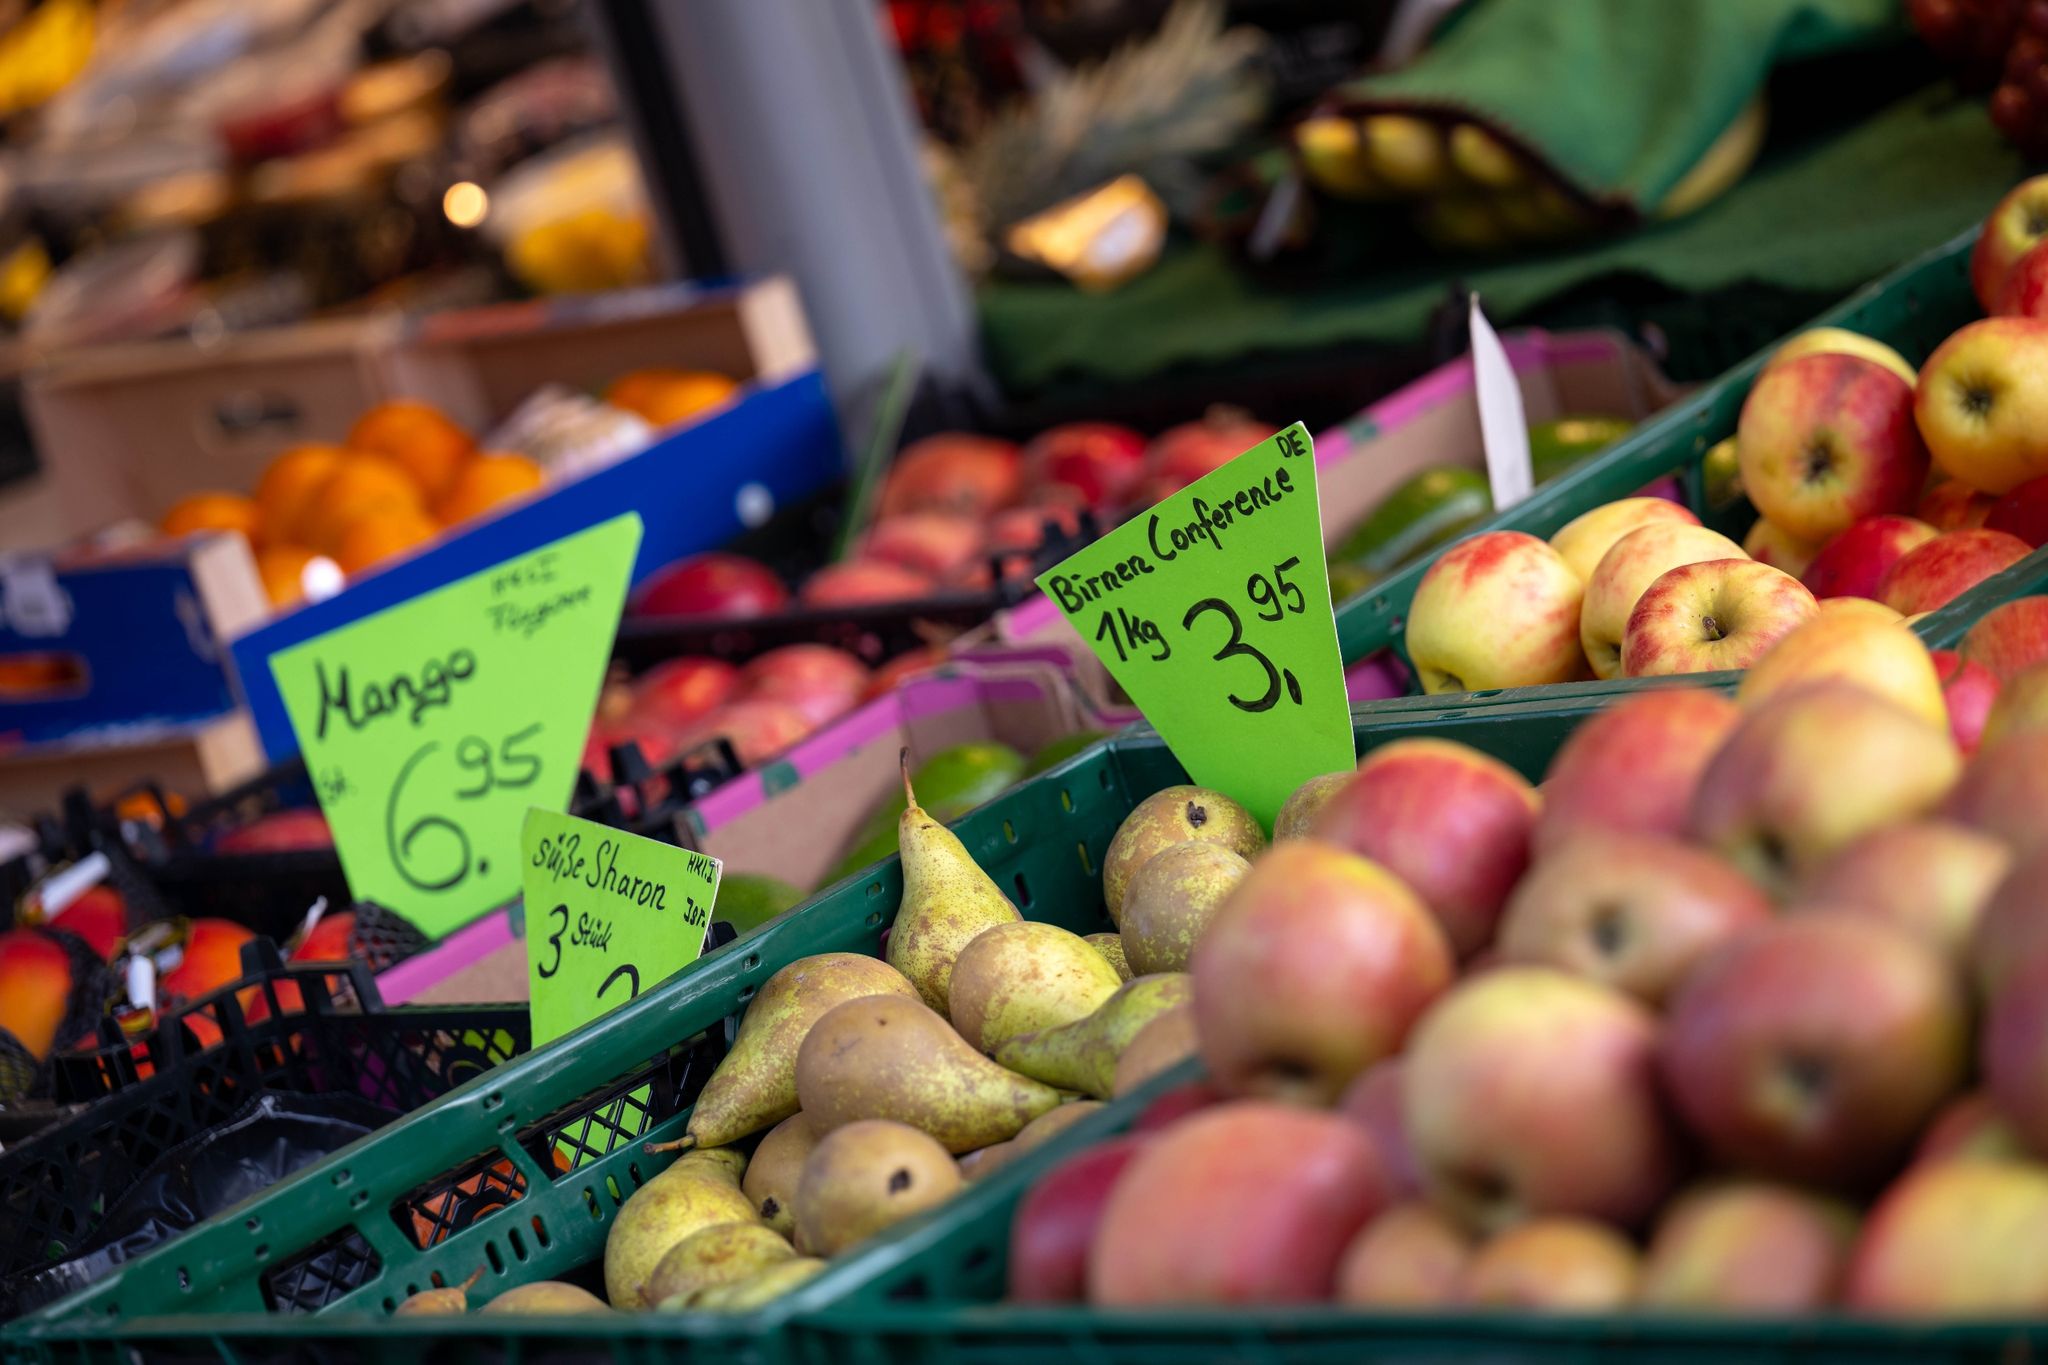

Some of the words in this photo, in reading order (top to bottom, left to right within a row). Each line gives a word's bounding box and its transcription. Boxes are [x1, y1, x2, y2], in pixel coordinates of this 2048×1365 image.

[1276, 429, 1306, 458] DE
[1049, 554, 1155, 614] Birnen
[1148, 467, 1295, 562] Conference
[315, 648, 477, 743] Mango
[586, 839, 667, 911] Sharon
[537, 903, 569, 979] 3
[571, 912, 613, 953] Stück
